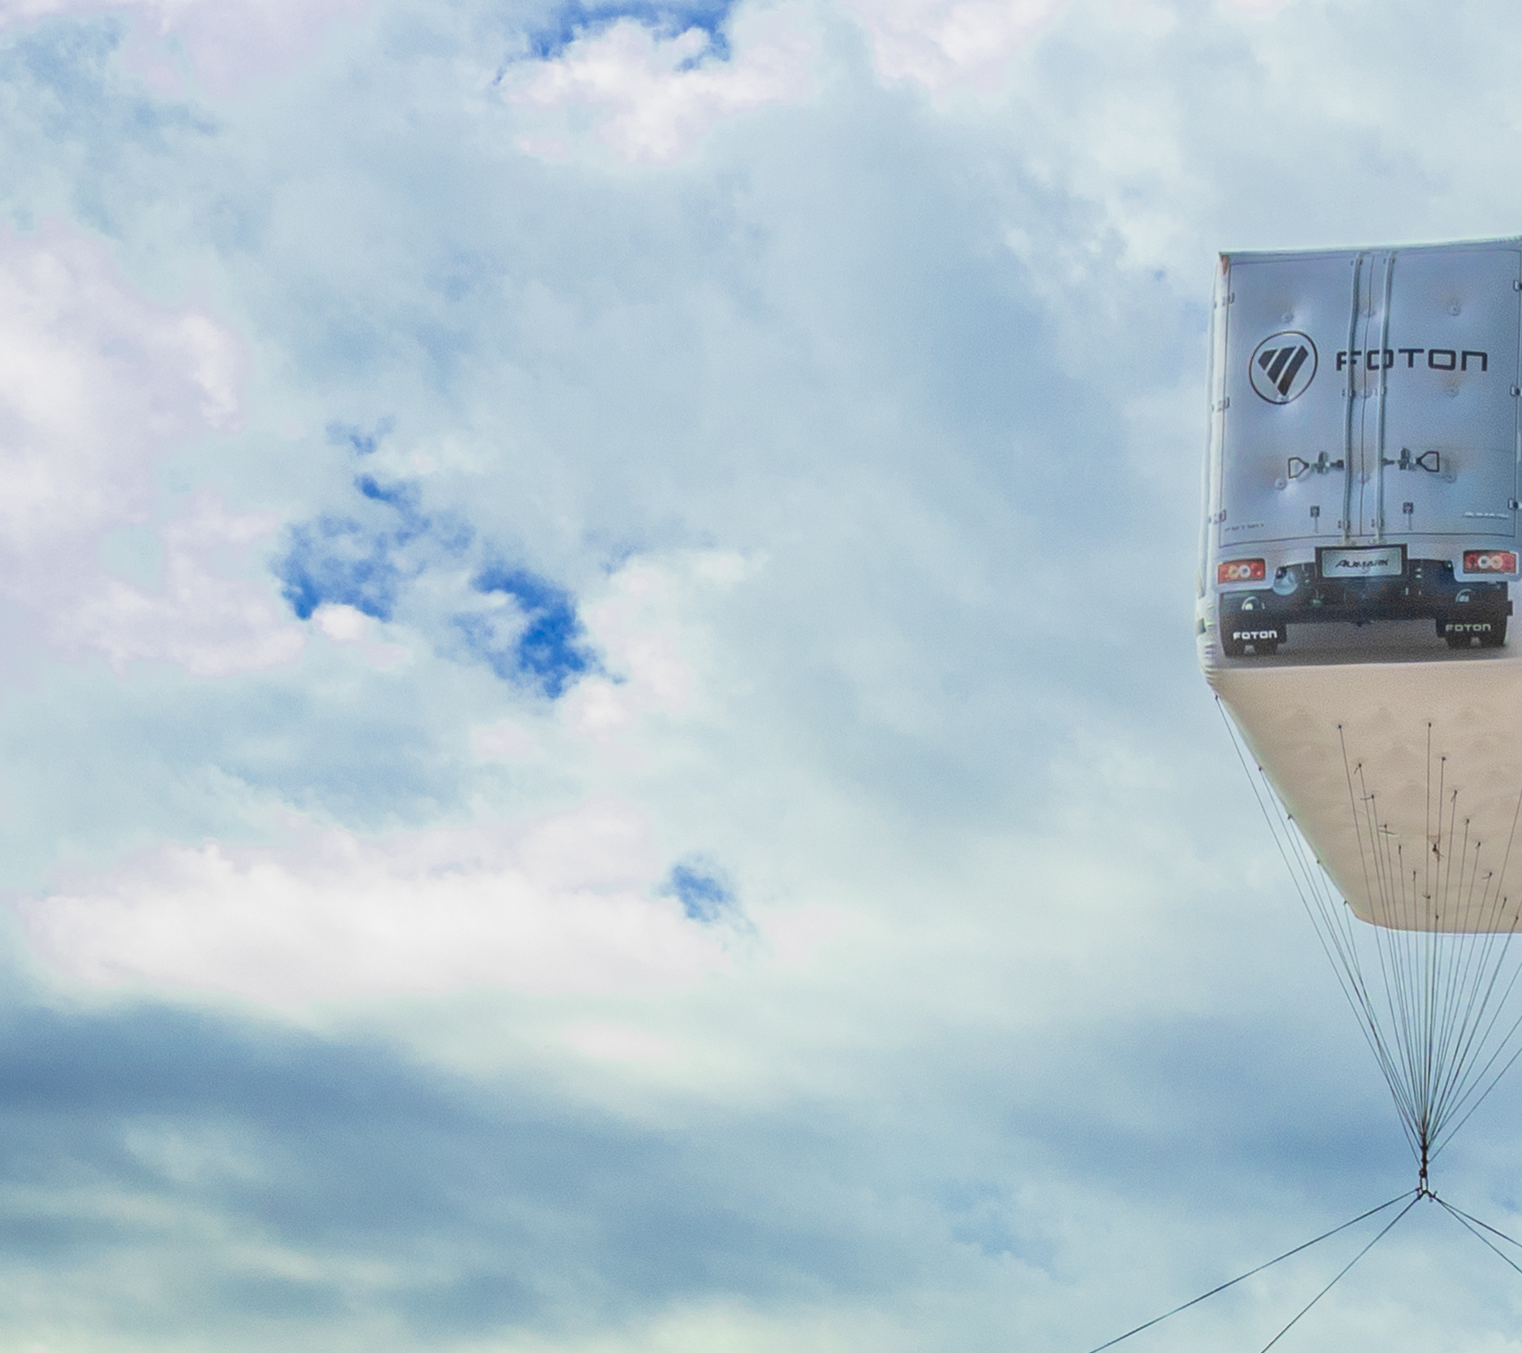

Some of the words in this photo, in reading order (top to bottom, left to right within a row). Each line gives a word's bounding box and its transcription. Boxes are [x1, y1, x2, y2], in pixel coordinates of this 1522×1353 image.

[1336, 348, 1488, 371] FOTON
[1445, 623, 1491, 632] FOTON
[1233, 630, 1278, 640] FOTON
